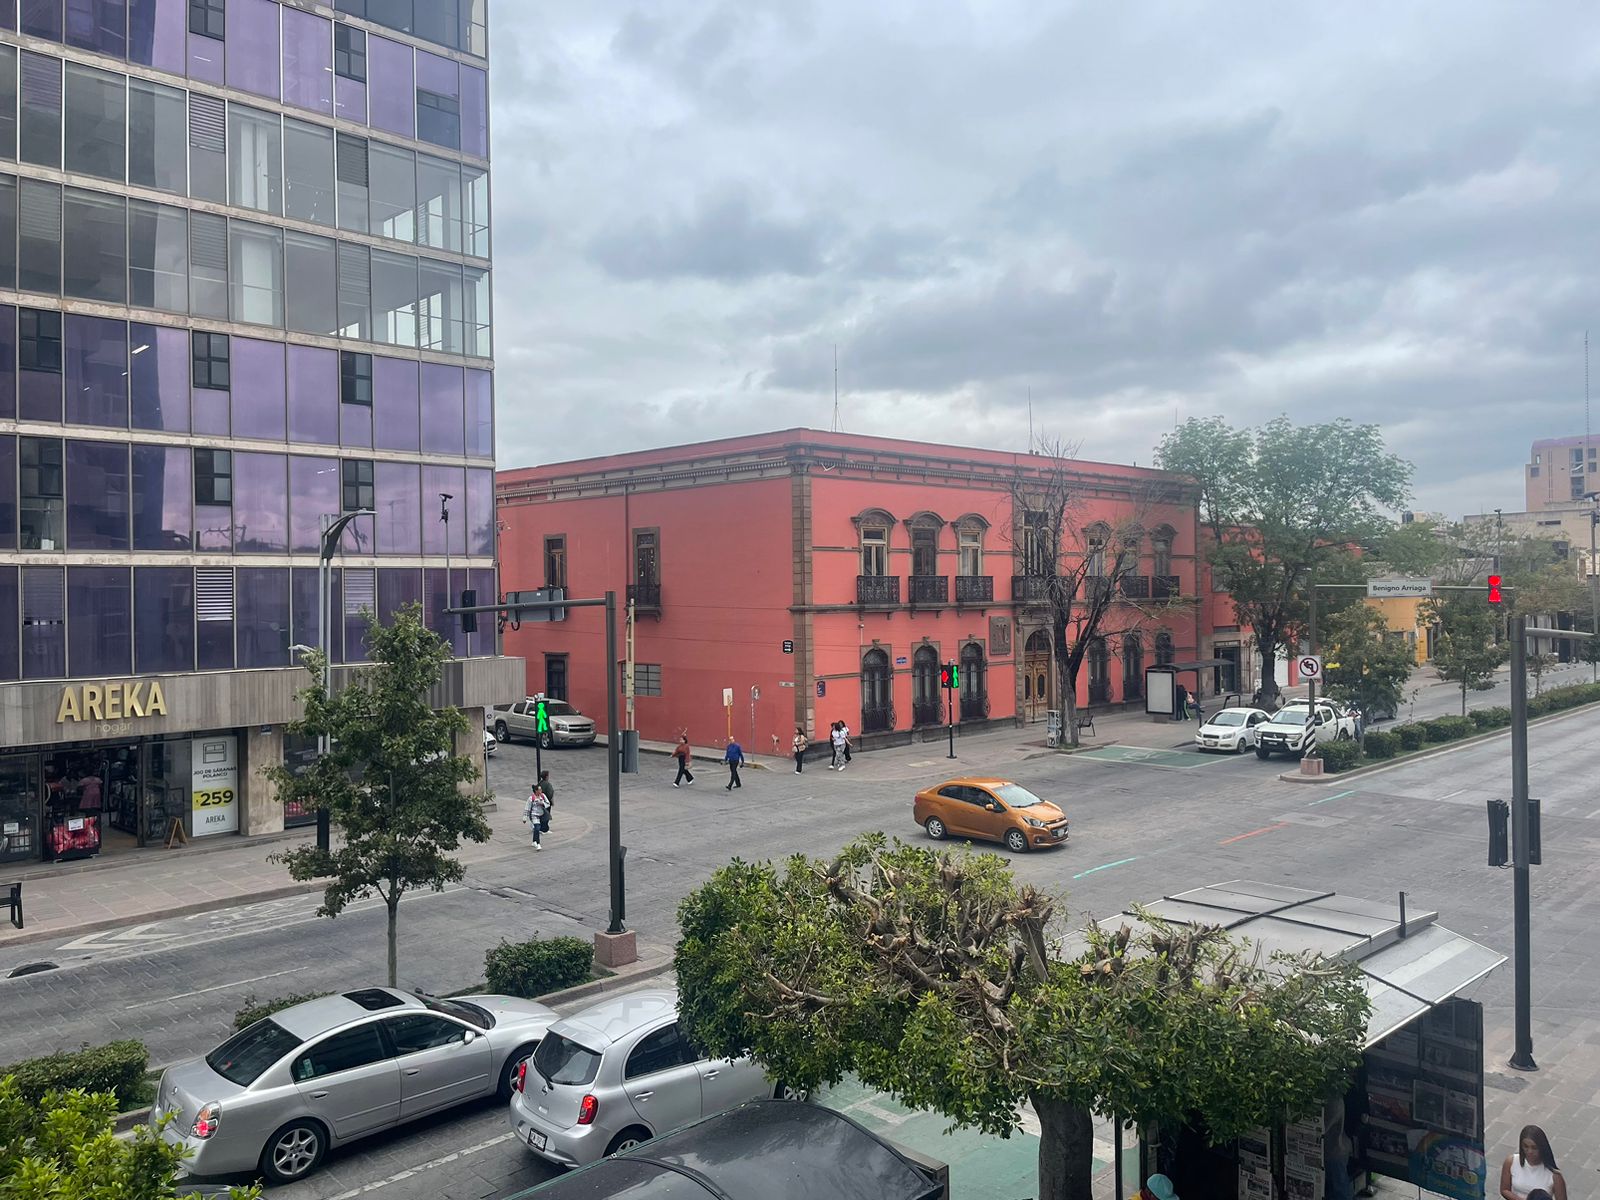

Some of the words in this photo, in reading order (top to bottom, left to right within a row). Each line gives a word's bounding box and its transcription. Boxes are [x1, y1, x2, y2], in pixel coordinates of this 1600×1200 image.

[1372, 584, 1400, 592] Benigno
[1401, 584, 1426, 592] Arriaga
[56, 681, 167, 723] AREKA
[94, 722, 132, 735] hogar
[205, 814, 226, 824] AREKA
